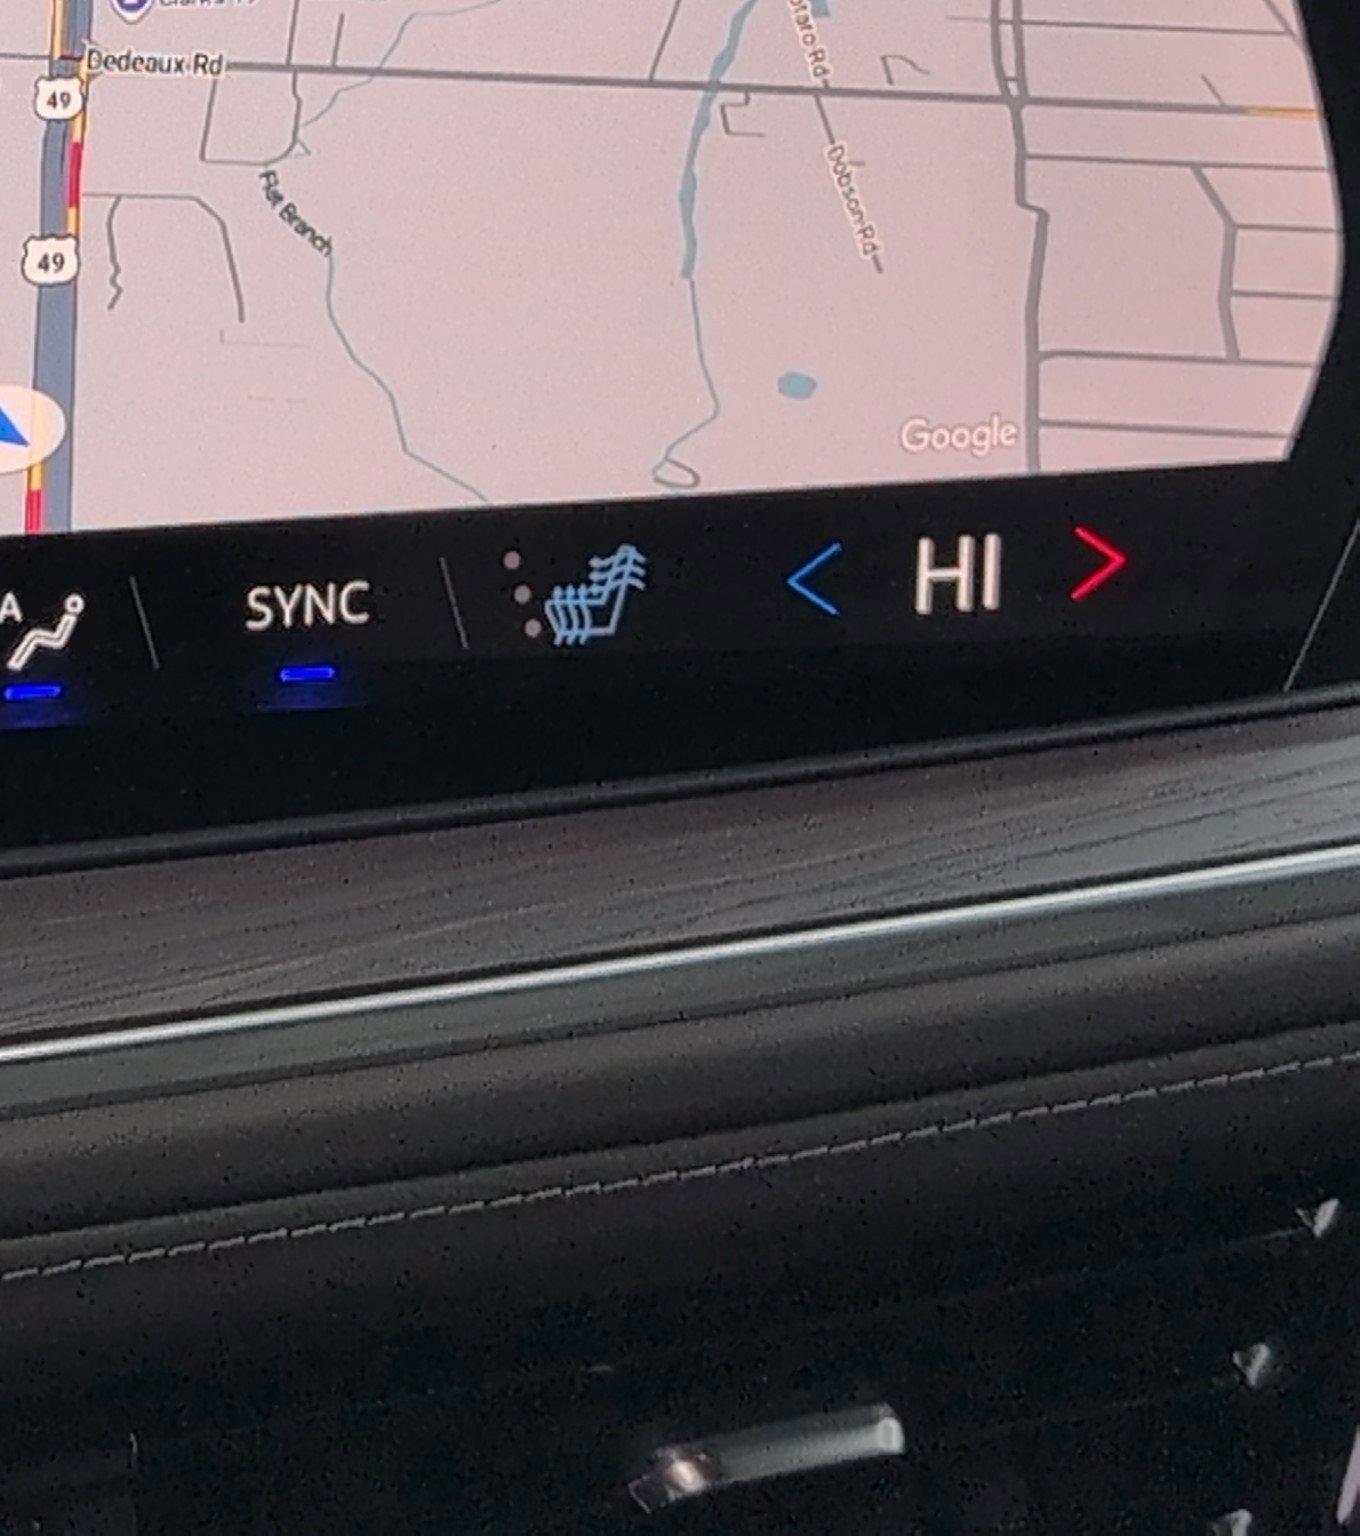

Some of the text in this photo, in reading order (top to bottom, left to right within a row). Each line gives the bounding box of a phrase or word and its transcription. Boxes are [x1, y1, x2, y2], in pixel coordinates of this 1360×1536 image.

[85, 47, 224, 76] Dedeaux Rd
[806, 47, 831, 80] Rd
[45, 91, 72, 109] 49
[259, 169, 333, 258] Flat Branch
[828, 144, 879, 256] Dobson Rd
[36, 252, 66, 274] 49
[900, 413, 1018, 458] Google
[915, 532, 1002, 615] HI
[245, 580, 371, 631] SYNC
